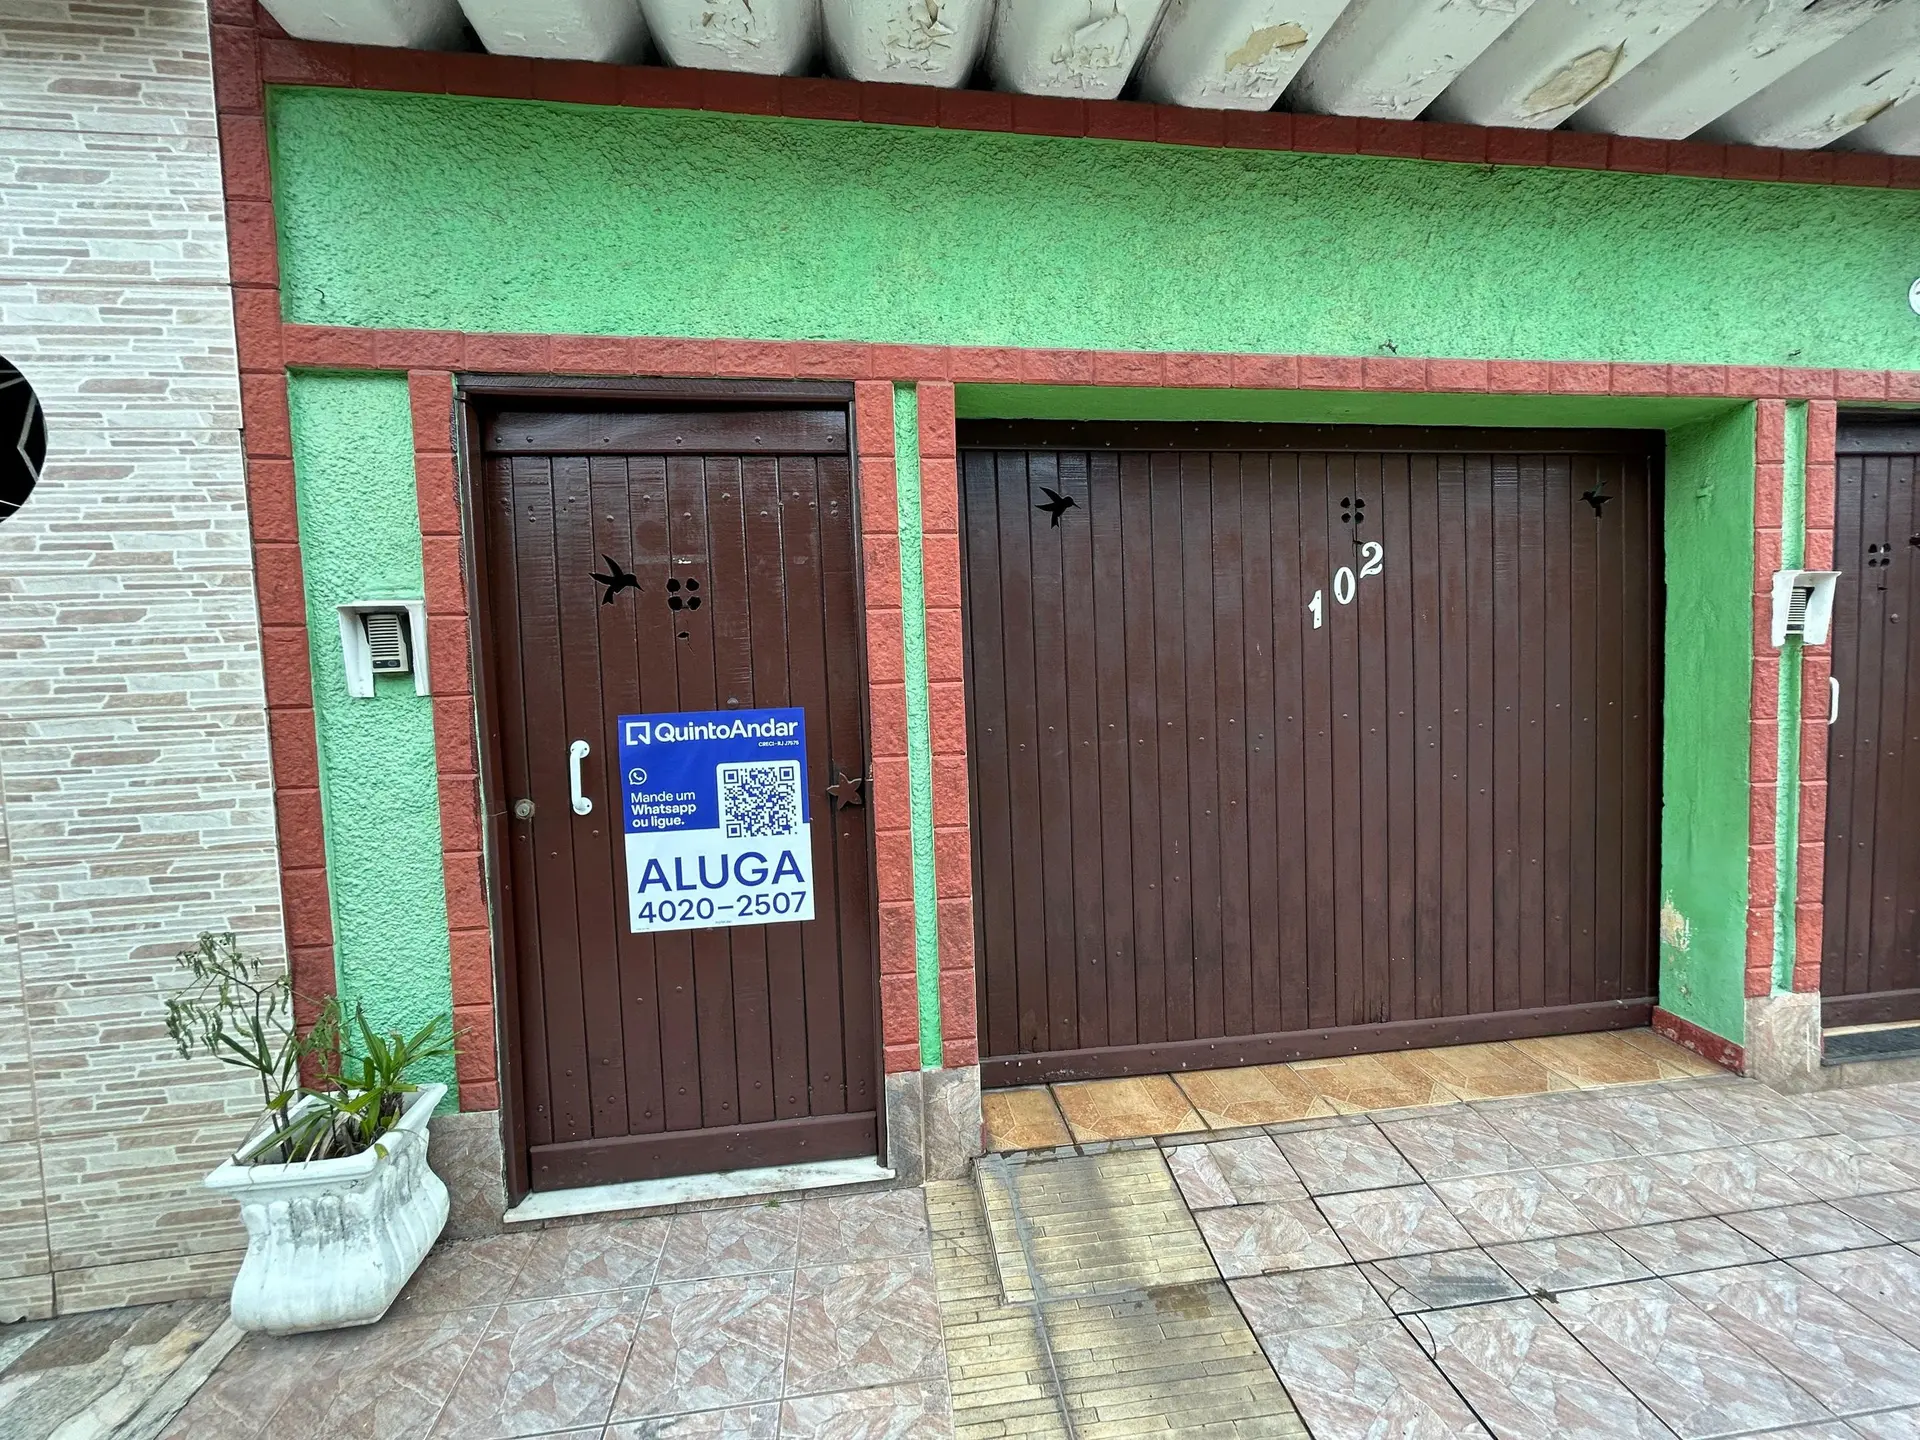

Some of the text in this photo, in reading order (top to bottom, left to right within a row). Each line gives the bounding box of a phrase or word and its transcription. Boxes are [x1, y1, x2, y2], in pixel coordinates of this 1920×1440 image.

[1308, 541, 1384, 629] 102
[654, 718, 798, 742] QuintoAndar
[630, 790, 696, 803] Mande um
[631, 803, 697, 815] Whatsapp
[632, 815, 685, 829] ou ligue.
[637, 850, 805, 894] ALUGA
[638, 891, 807, 923] 4020-2507
